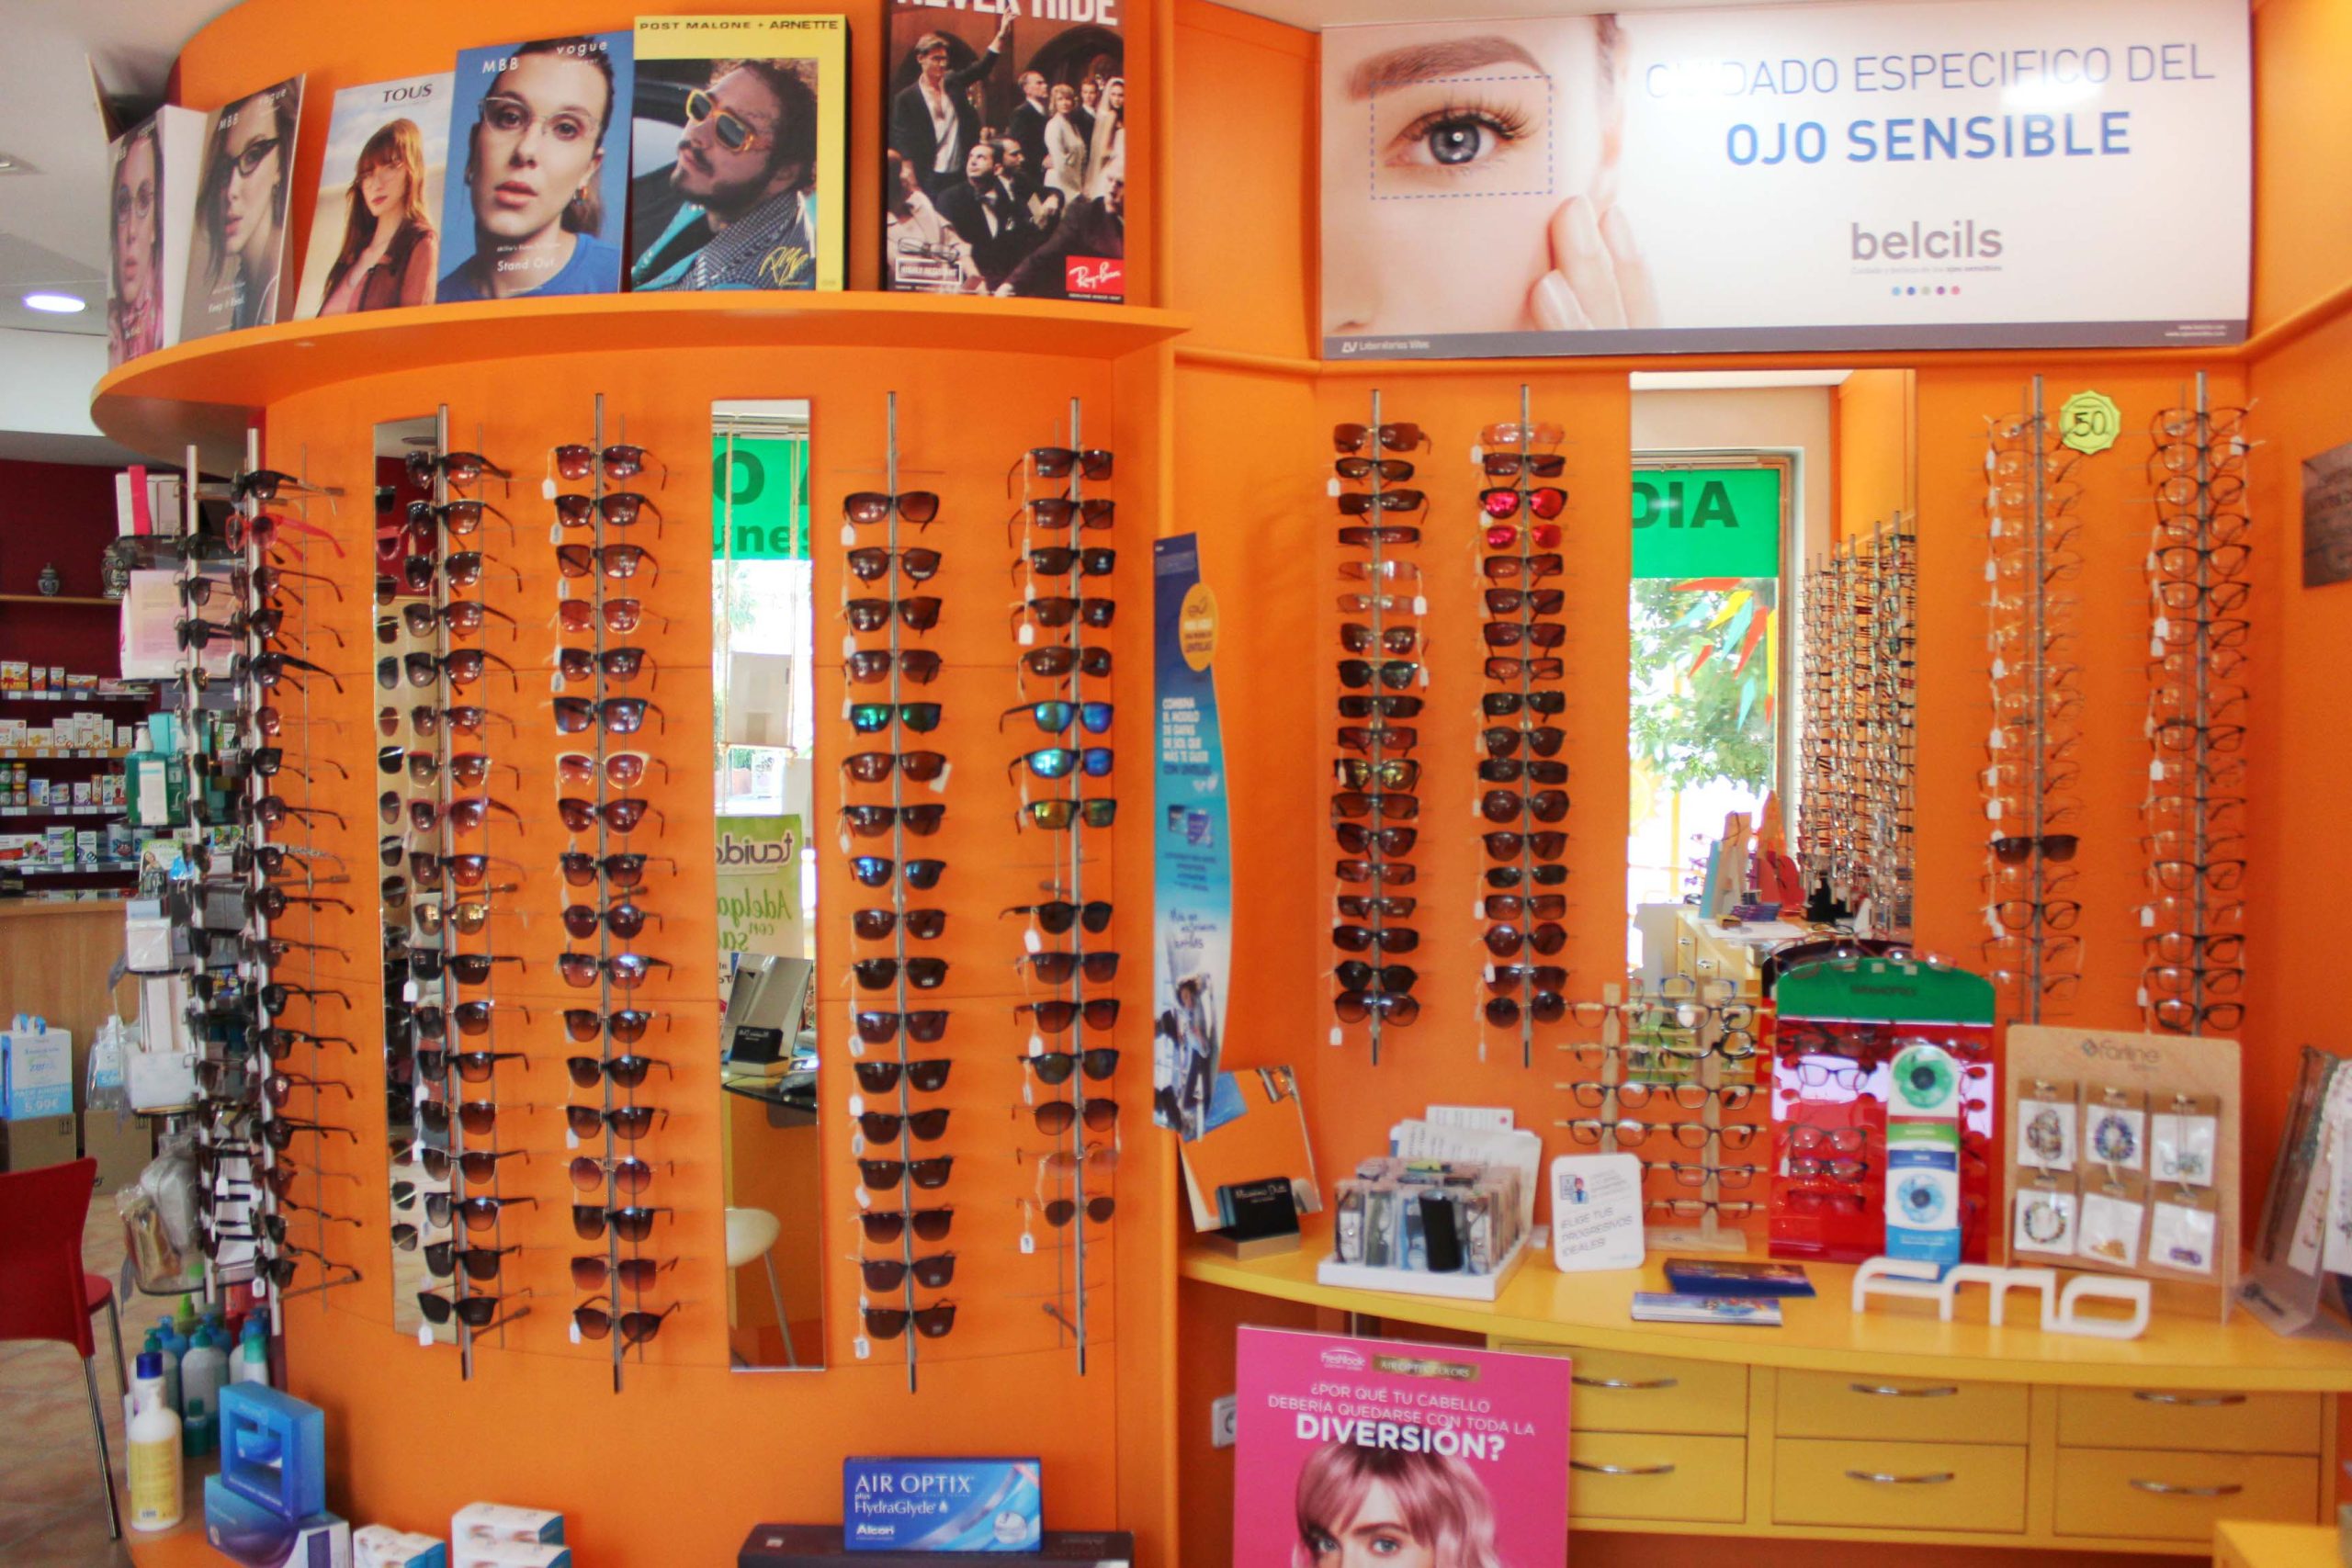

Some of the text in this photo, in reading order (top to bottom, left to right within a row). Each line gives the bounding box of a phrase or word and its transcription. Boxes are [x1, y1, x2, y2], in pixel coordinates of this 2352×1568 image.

[639, 22, 680, 30] POST
[685, 21, 751, 29] MALONE
[769, 20, 838, 29] ARNETTE
[556, 40, 608, 55] vogue
[481, 57, 519, 73] MBB
[1646, 43, 2216, 98] CDADO ESPECIFICO DEL
[383, 84, 433, 103] TOUS
[1726, 111, 2131, 166] OJO SENSIBLE
[1851, 220, 2003, 261] belcils
[497, 260, 529, 272] Stand
[2073, 410, 2107, 437] 50
[713, 525, 809, 553] une
[1311, 1383, 1351, 1398] ¿POR
[1393, 1391, 1413, 1405] TU
[1417, 1393, 1490, 1414] CABELLO
[1267, 1394, 1535, 1437] DEBERÍA QUEDARSE CON TODA LA
[1296, 1412, 1505, 1461] DIVERSIÓN?
[854, 1474, 971, 1494] AIR OPTIX
[854, 1500, 935, 1518] HydraGlyde
[856, 1524, 895, 1535] Alcon
